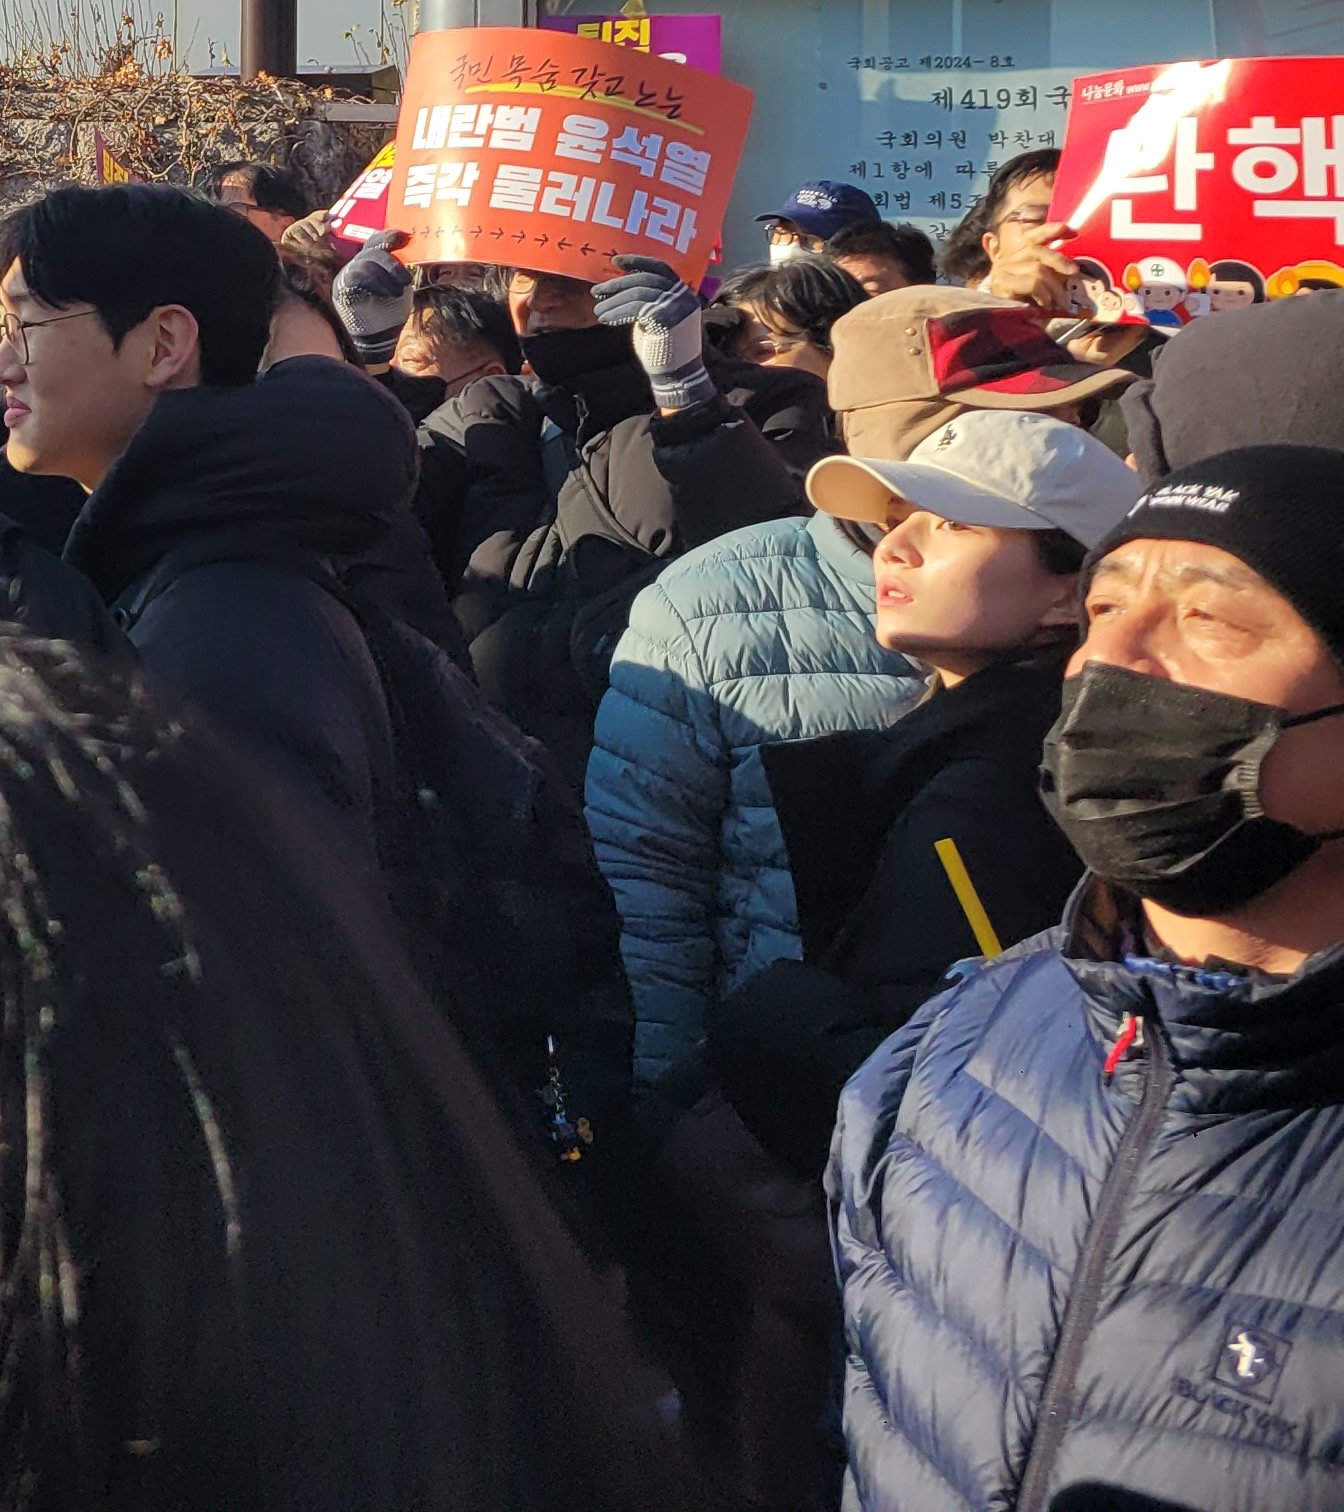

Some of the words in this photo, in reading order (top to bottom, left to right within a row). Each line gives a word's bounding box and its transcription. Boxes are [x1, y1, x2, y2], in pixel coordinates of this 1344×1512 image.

[577, 18, 651, 53] 퇴진
[846, 55, 910, 70] 국회공고
[451, 55, 494, 86] 국민
[508, 57, 560, 90] 목숨
[570, 66, 626, 101] 갖고
[634, 85, 685, 121] 노는
[931, 88, 1038, 113] 제419회
[1081, 79, 1125, 101] 나눔문화
[411, 104, 542, 152] 내란범
[555, 118, 711, 195] 윤석열
[876, 129, 968, 150] 국회의원
[989, 128, 1057, 151] 박찬대
[849, 160, 933, 180] 제1항에
[402, 161, 480, 209] 즉각
[488, 164, 697, 254] 물러나라
